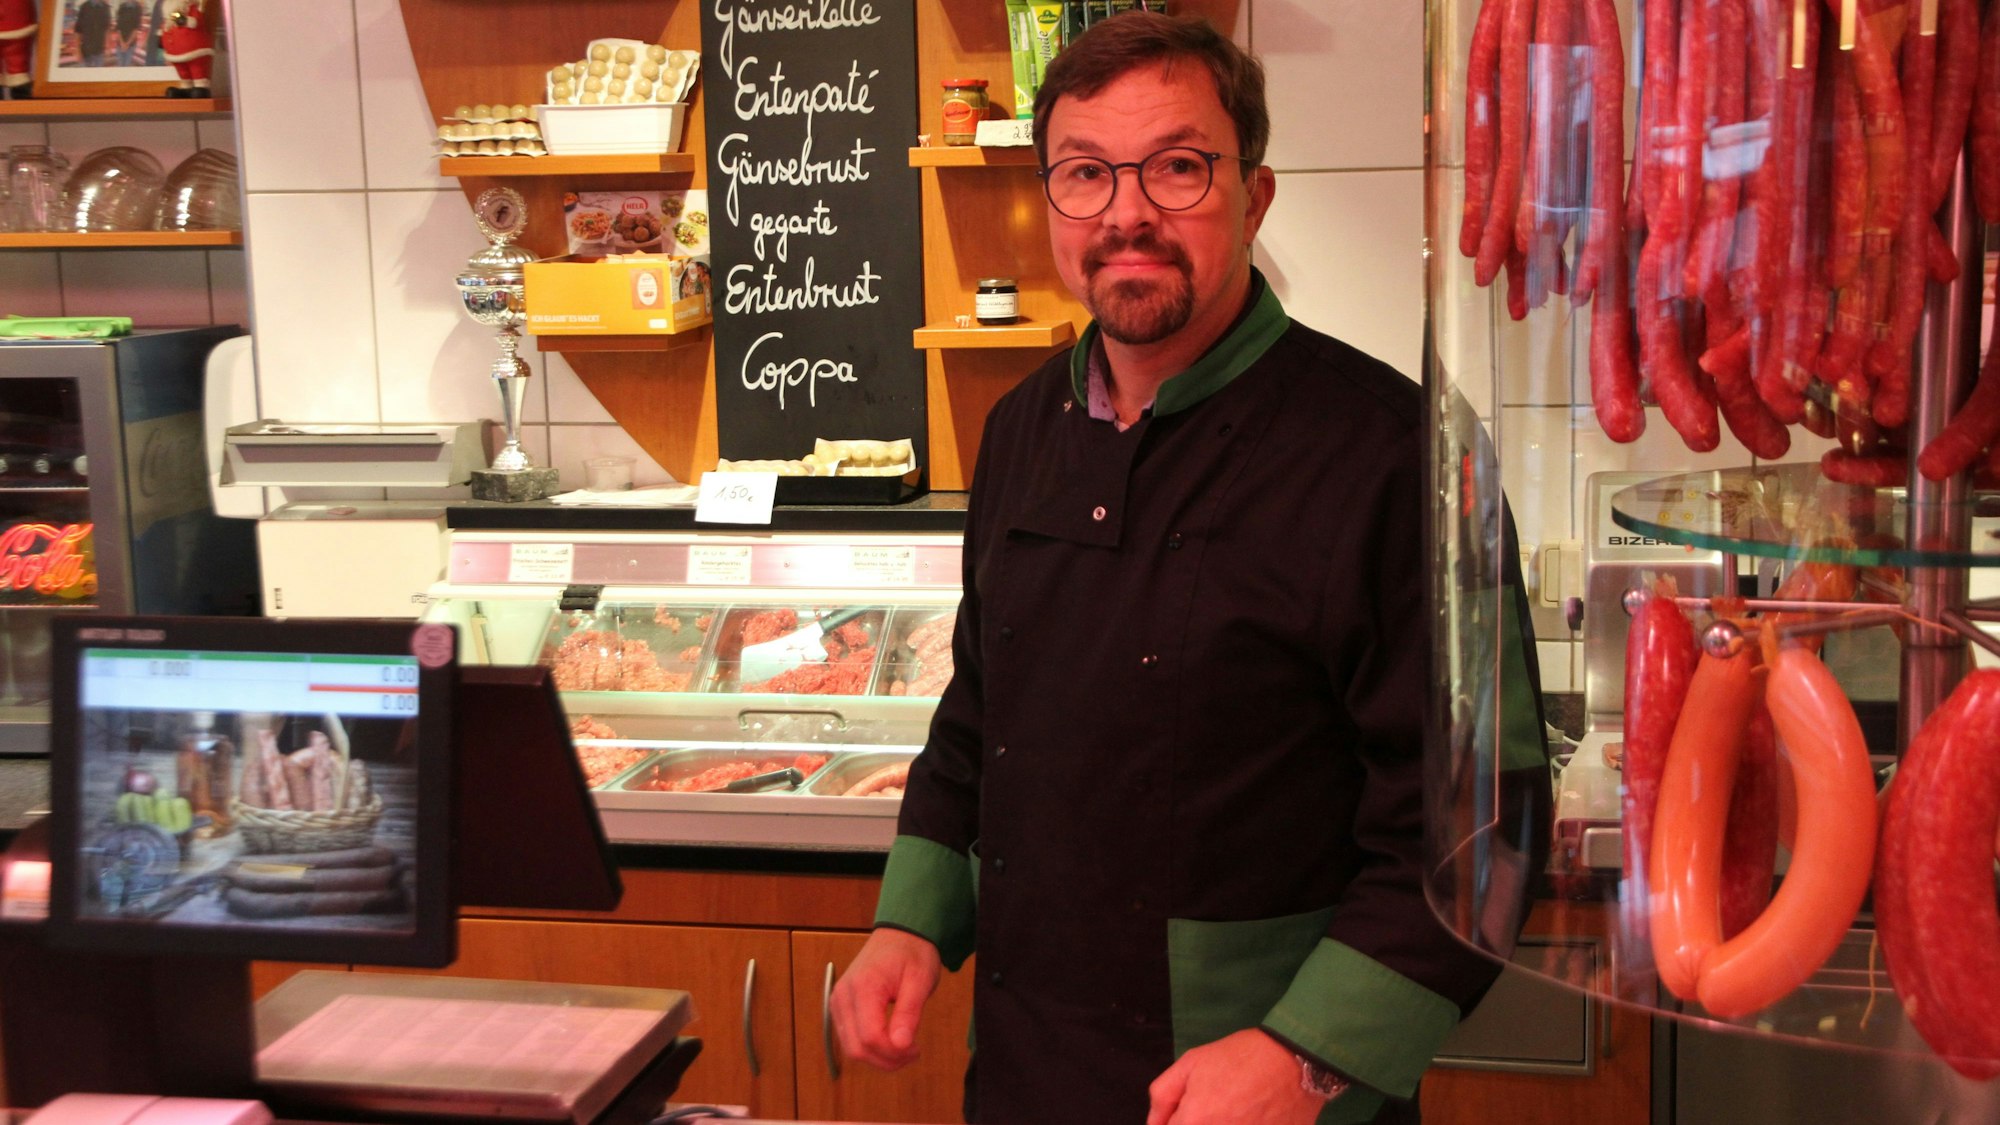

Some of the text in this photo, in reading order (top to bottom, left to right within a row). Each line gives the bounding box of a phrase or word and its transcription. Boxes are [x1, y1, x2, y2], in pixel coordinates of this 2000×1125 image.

[735, 56, 880, 138] Entenpaté
[717, 132, 876, 227] Gänsebrust
[750, 199, 838, 264] gegarte
[724, 255, 882, 315] Entenbrust
[741, 331, 858, 411] Coppa
